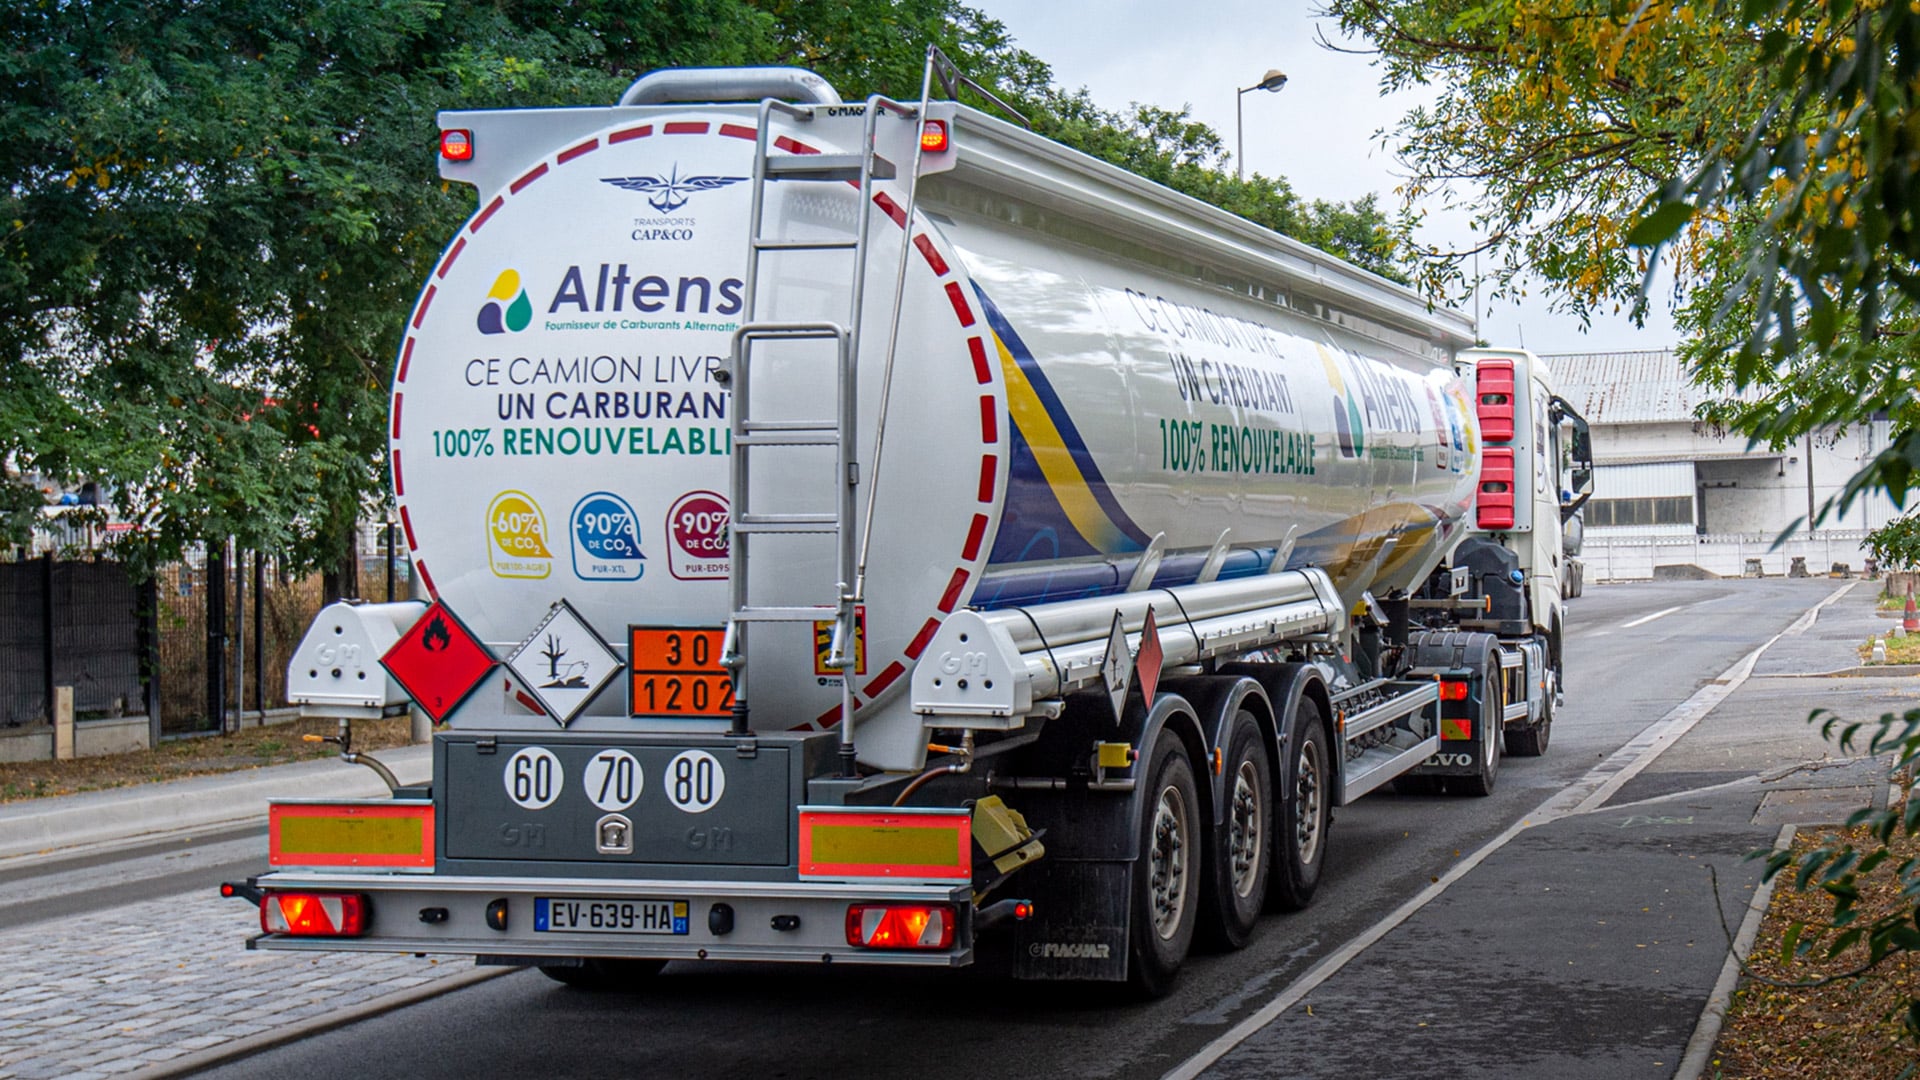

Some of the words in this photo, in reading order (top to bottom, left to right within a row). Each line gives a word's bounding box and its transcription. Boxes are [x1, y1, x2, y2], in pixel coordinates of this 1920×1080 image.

[838, 106, 886, 117] MAGR
[631, 229, 693, 241] CAP&CO
[633, 218, 696, 227] TRANSPORTS
[548, 263, 744, 315] Altens
[1124, 286, 1168, 334] CE
[545, 321, 600, 331] Fournisseur
[603, 320, 617, 330] de
[620, 319, 681, 330] Carburants
[465, 358, 501, 386] CE
[508, 355, 642, 385] CAMION
[655, 355, 723, 384] LIVR
[1168, 352, 1203, 402] UN
[1201, 357, 1295, 415] CARBURANT
[497, 392, 535, 420] UN
[545, 390, 732, 420] CARBURAN
[432, 428, 494, 458] 100%
[1160, 418, 1206, 475] 100%
[1210, 422, 1316, 476] RENOUVELABLE
[490, 511, 541, 535] -60%
[577, 512, 633, 536] -90%
[588, 540, 601, 549] DE
[603, 538, 633, 557] CO2
[686, 539, 700, 549] DE
[592, 565, 626, 574] PUR-XTL
[686, 564, 730, 573] PUR-ED95
[314, 642, 361, 669] GM
[665, 633, 709, 667] 30
[940, 650, 989, 677] GM
[435, 697, 442, 707] 3
[644, 677, 735, 711] 1202
[514, 754, 553, 803] 60
[597, 755, 635, 804] 70
[675, 756, 714, 805] 80
[552, 902, 672, 930] EV-639-HA
[675, 919, 687, 932] 21
